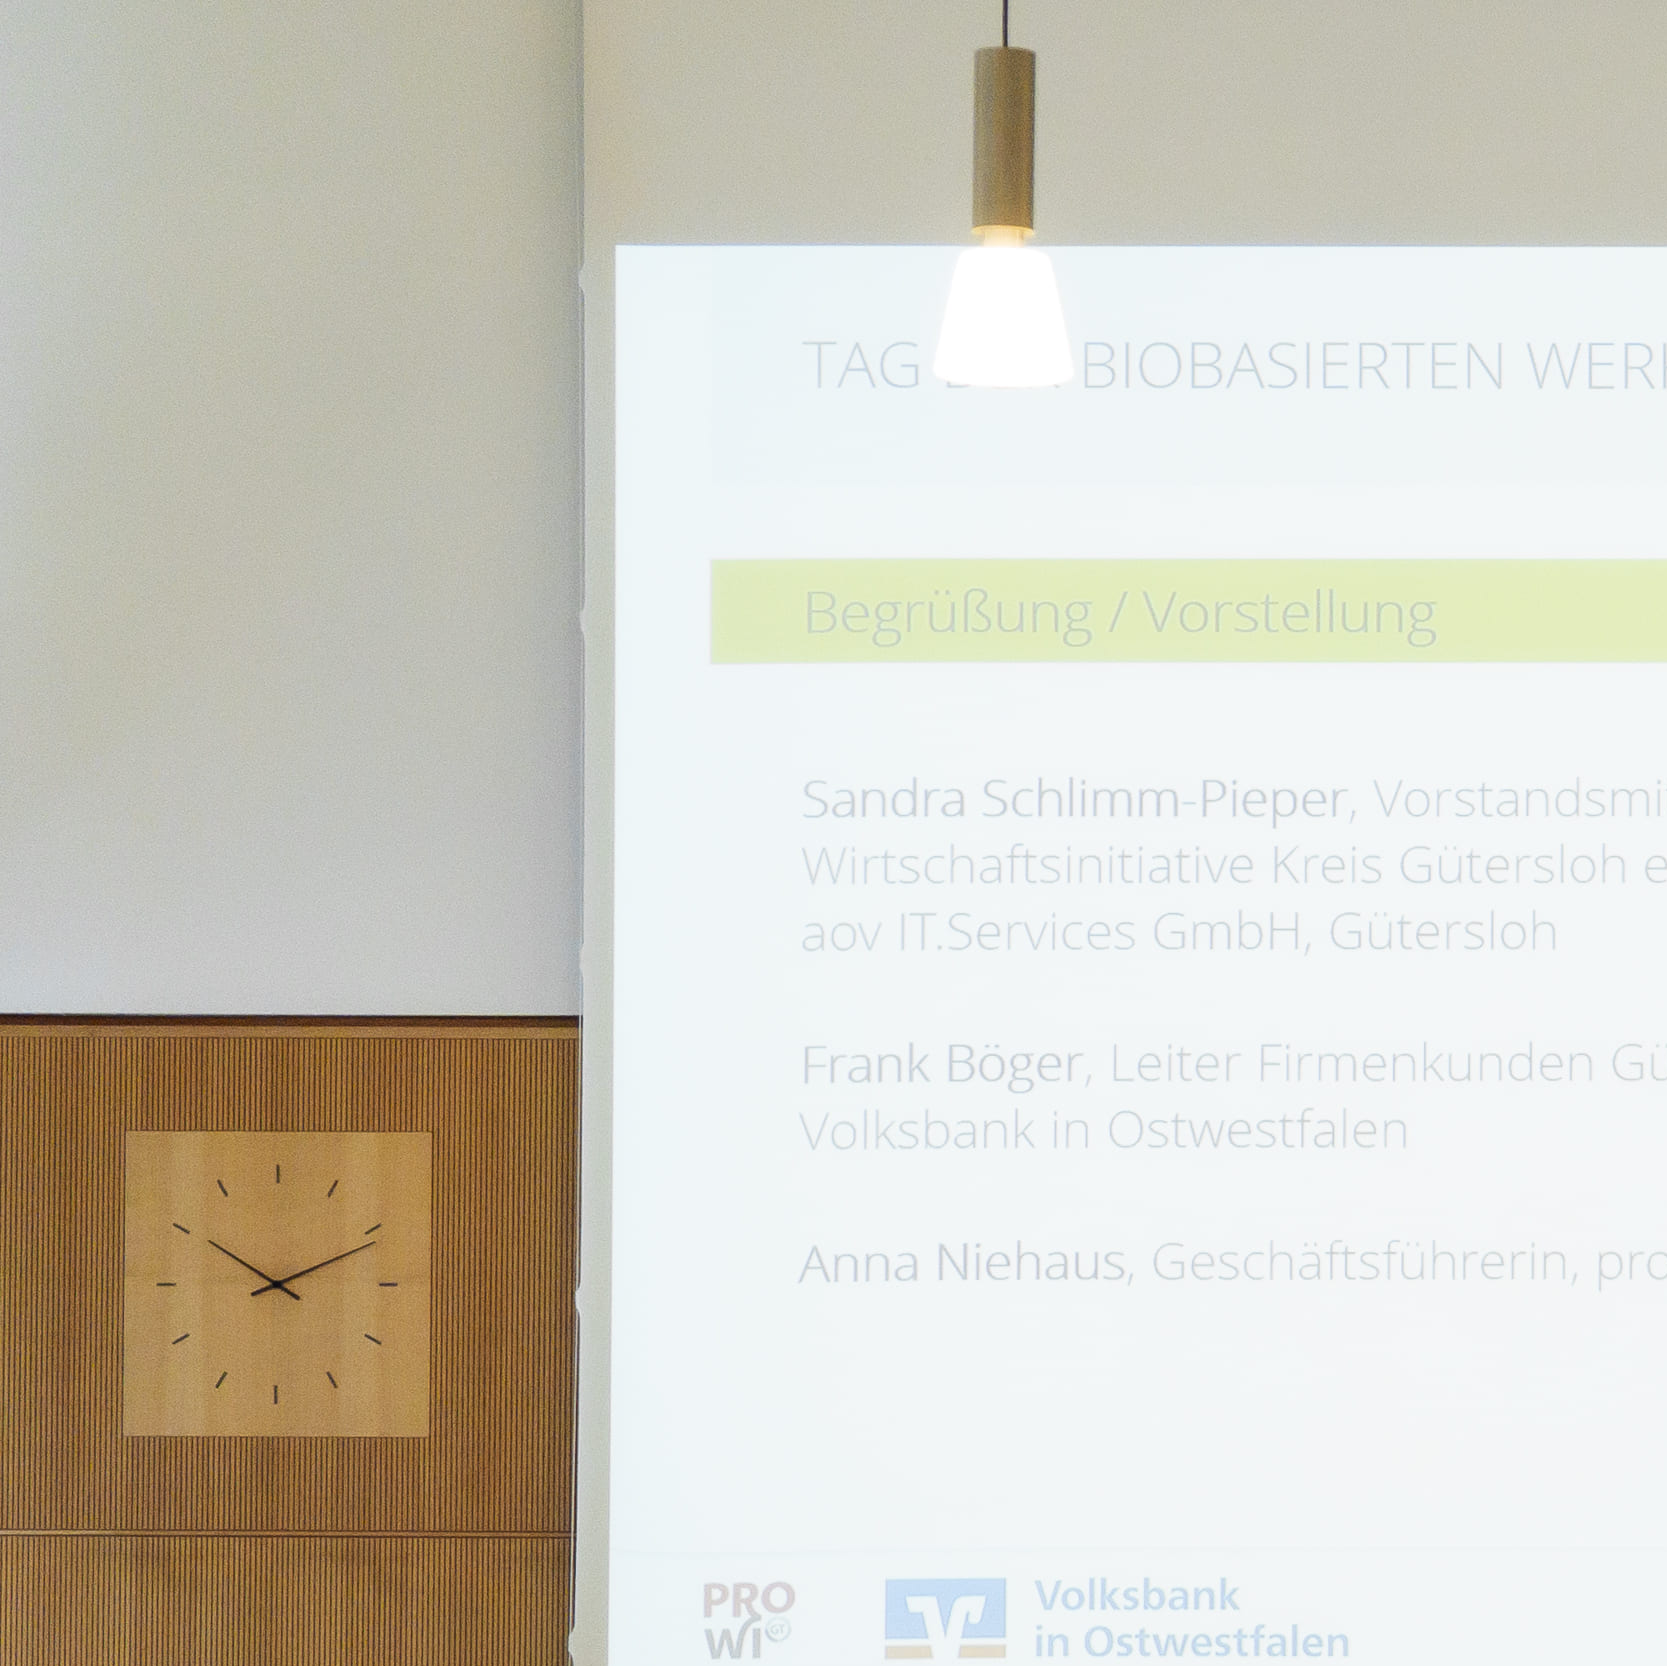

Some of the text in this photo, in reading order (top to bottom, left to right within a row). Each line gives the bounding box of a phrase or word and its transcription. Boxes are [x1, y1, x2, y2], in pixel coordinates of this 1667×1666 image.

[800, 340, 920, 390] TAG
[1083, 340, 1503, 391] BIOBASIERTEN
[806, 587, 1438, 648] Begrüßung / Vorstellung
[801, 775, 966, 819] Sandra
[981, 775, 1357, 830] Schlimm-Pieper,
[801, 842, 1254, 886] Wirtschaftsinitiative
[1273, 844, 1383, 885] Kreis
[1399, 842, 1627, 885] Gütersloh
[801, 908, 1557, 957] aov IT.Services GmbH, Gütersloh
[803, 1040, 932, 1085] Frank
[947, 1043, 1092, 1095] Böger,
[1112, 1042, 1243, 1083] Leiter
[1259, 1039, 1593, 1083] Firmenkunden
[798, 1106, 1407, 1152] Volksbank in Ostwestfalen
[797, 1244, 919, 1285] Anna
[937, 1239, 1134, 1287] Niehaus,
[1152, 1239, 1578, 1288] Geschäftsführerin,
[703, 1580, 796, 1618] PRO
[1033, 1575, 1241, 1612] Volksbank
[1035, 1623, 1350, 1659] in Ostwestfalen
